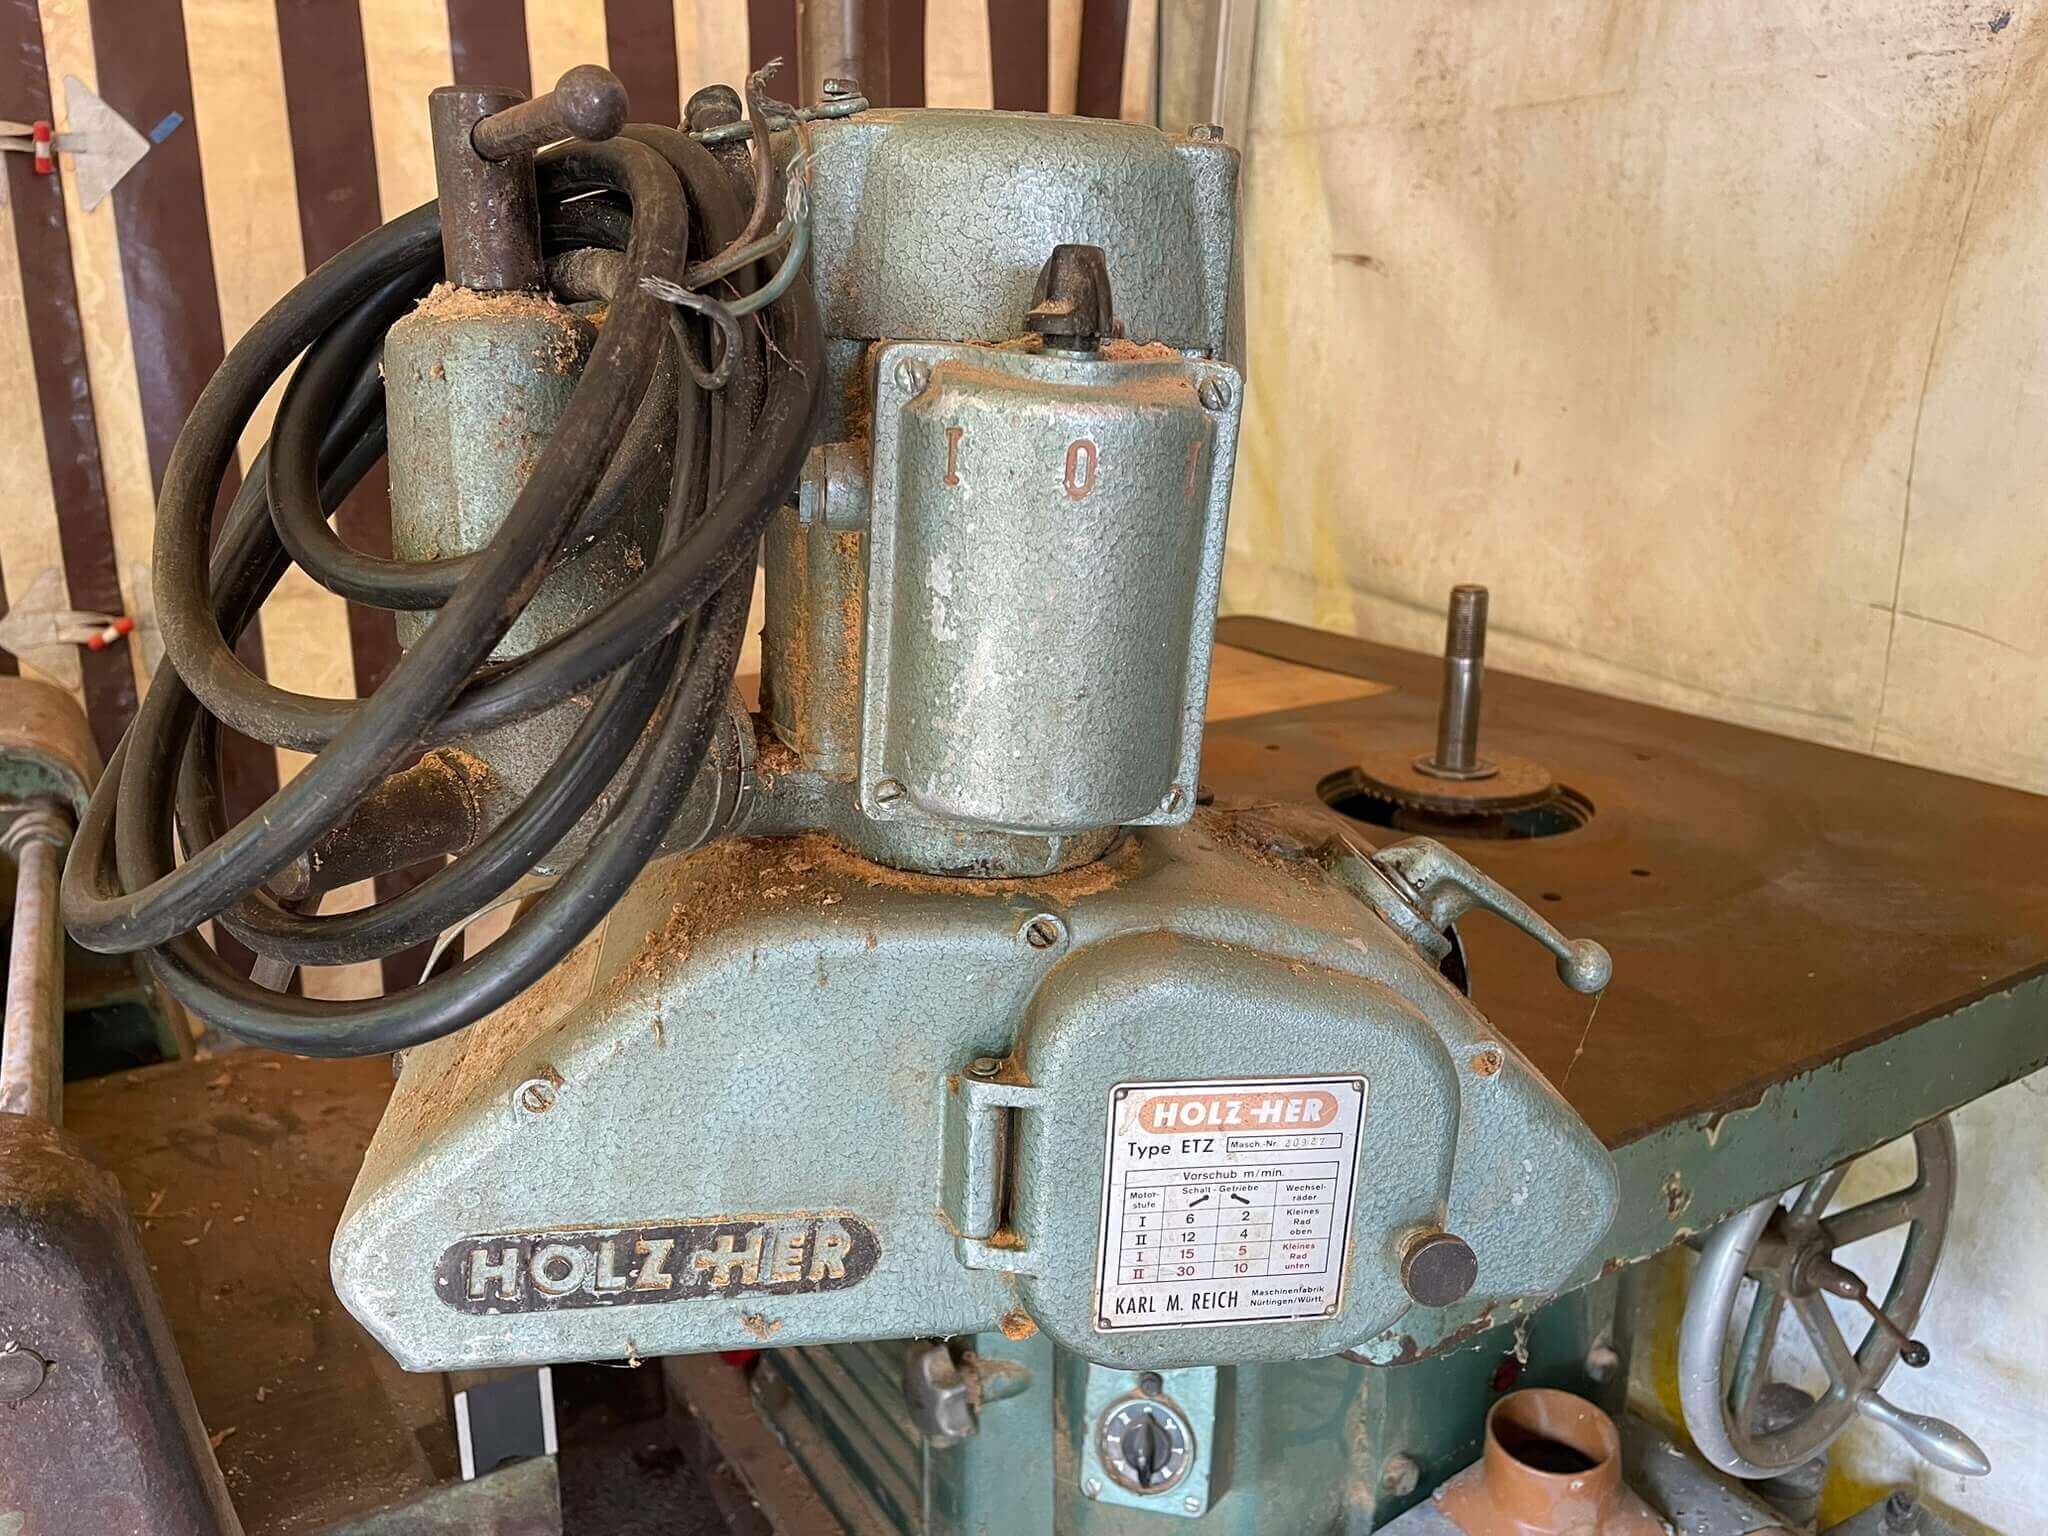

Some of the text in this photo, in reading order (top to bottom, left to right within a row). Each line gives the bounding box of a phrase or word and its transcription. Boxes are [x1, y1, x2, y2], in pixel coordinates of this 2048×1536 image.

[1152, 1098, 1324, 1128] HOLZ-HER
[1128, 1139, 1215, 1159] Type ETZ
[1183, 1169, 1238, 1181] Vorschub
[1133, 1201, 1156, 1209] stufe
[1286, 1208, 1320, 1216] Kleines
[1139, 1211, 1250, 1228] I 6 2
[1293, 1217, 1312, 1225] Rad
[1135, 1228, 1248, 1246] II 12 4
[1289, 1228, 1313, 1236] oben
[468, 1220, 852, 1299] HOLZ-HER
[1136, 1245, 1248, 1262] I 15 5
[1289, 1252, 1308, 1260] Rad
[1133, 1263, 1248, 1279] II 30 10
[1284, 1262, 1310, 1270] unten
[1251, 1285, 1325, 1297] Maschinenfabrik
[1115, 1290, 1239, 1315] KARL M. REICH
